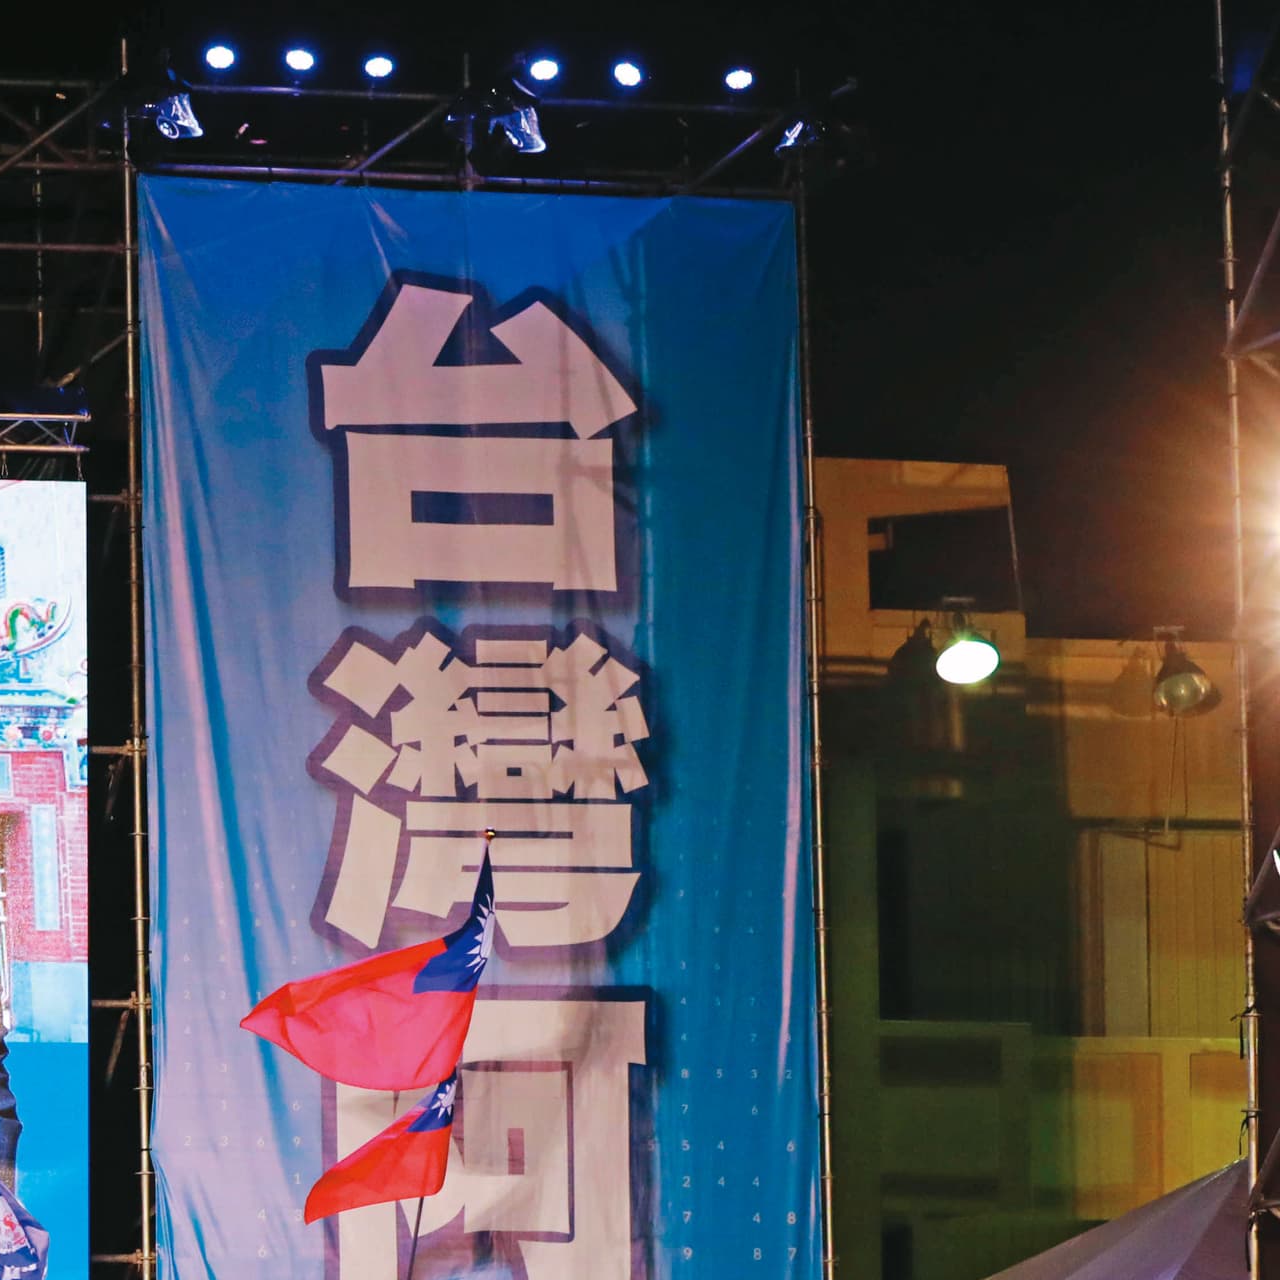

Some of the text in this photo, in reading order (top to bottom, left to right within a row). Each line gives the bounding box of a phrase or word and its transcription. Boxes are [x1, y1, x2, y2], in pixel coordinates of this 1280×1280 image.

[682, 1176, 691, 1188] 2
[683, 1210, 796, 1224] 7 4 8
[682, 1247, 797, 1262] 9 8 7
